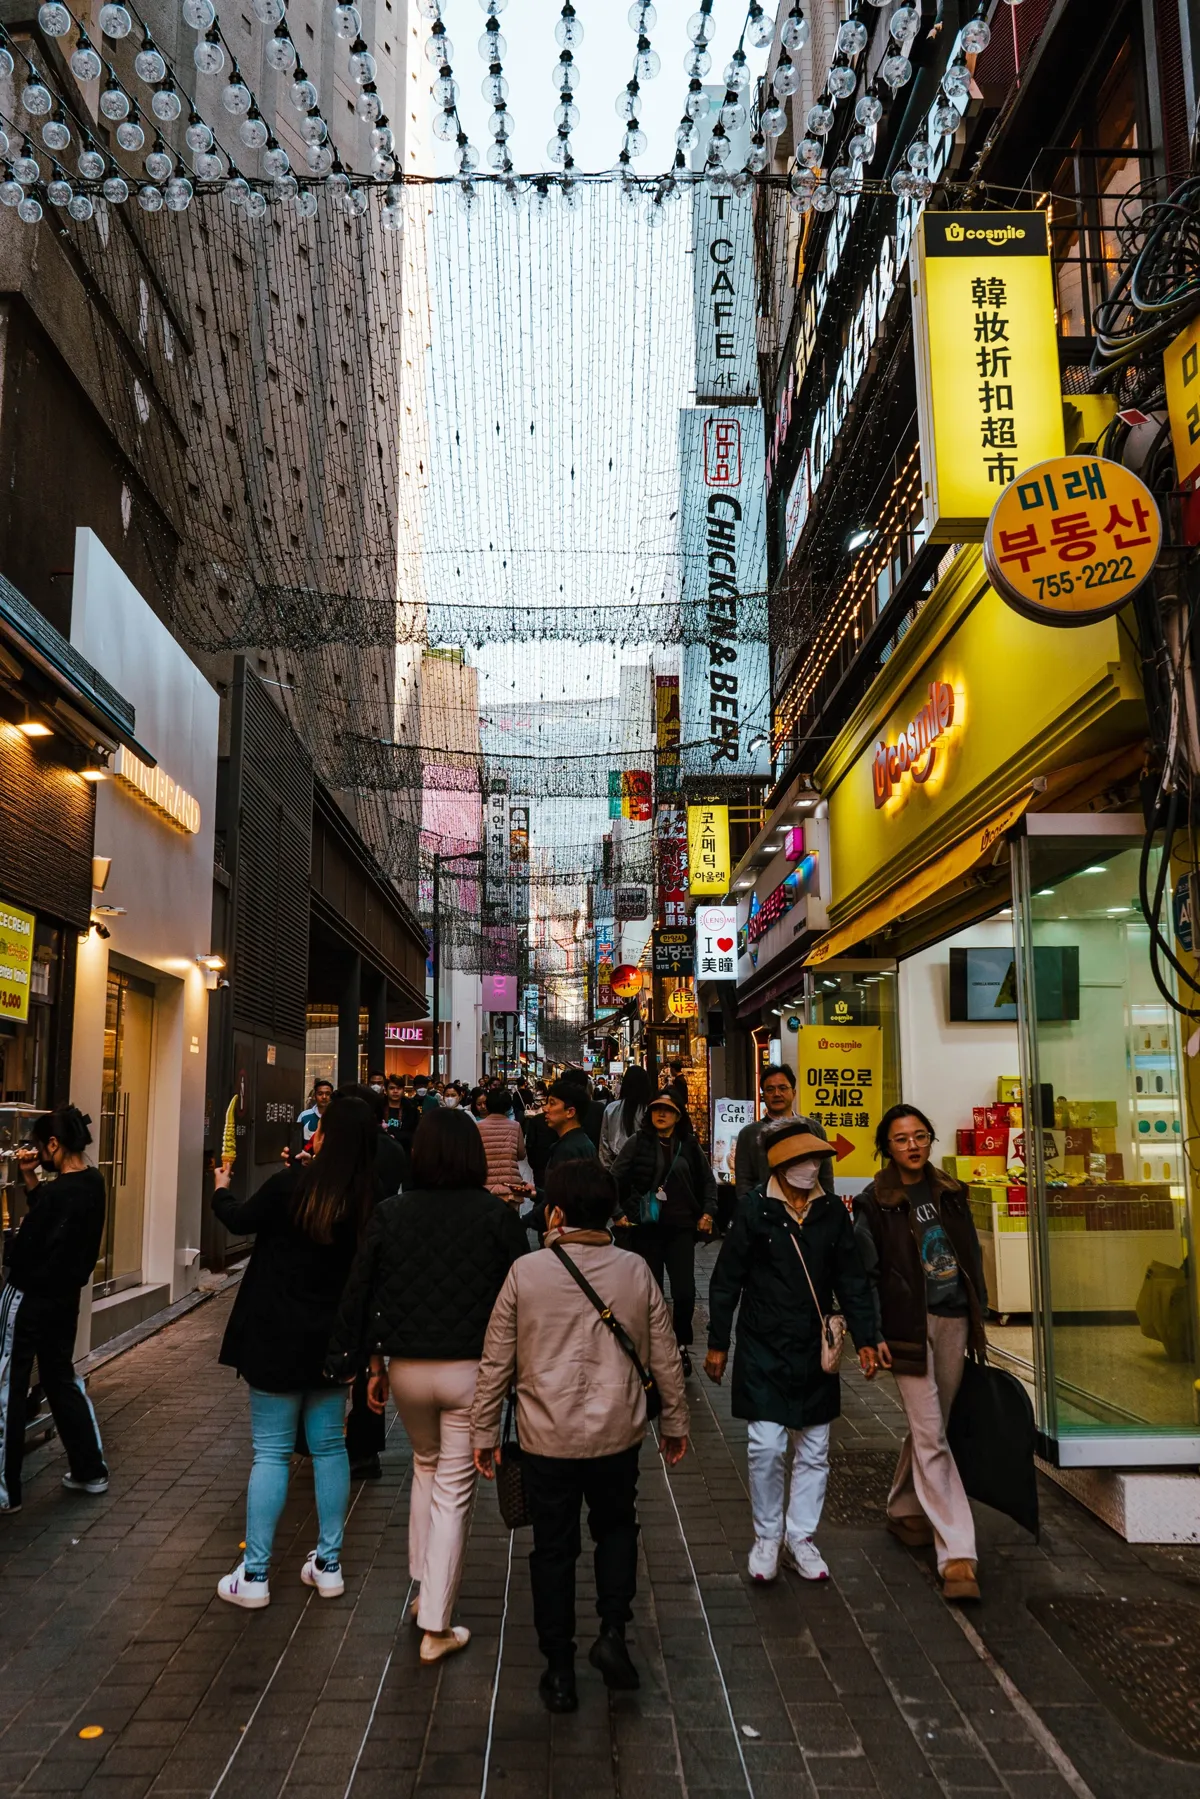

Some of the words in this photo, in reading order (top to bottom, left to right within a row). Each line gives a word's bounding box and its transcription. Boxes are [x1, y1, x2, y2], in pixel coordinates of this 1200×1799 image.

[966, 225, 1026, 245] cosmile
[709, 239, 736, 359] CAFE
[713, 372, 738, 389] 4F
[971, 276, 1019, 487] 韓妝折扣超市
[1017, 462, 1107, 512] 미래
[998, 498, 1152, 574] 부동산
[705, 493, 742, 641] CHICKEN
[1032, 555, 1136, 600] 755-2222
[709, 669, 739, 763] BEER
[888, 681, 955, 785] cosmile
[701, 811, 716, 869] 코스메틱
[694, 871, 726, 883] 아울렛
[655, 945, 693, 961] 전당포
[704, 937, 713, 954] I
[701, 957, 734, 973] 美瞳
[829, 1040, 863, 1052] cosmile
[807, 1067, 873, 1087] 이쪽으로
[814, 1088, 864, 1107] 오세요
[720, 1113, 745, 1124] Cafe
[726, 1103, 745, 1114] Cat
